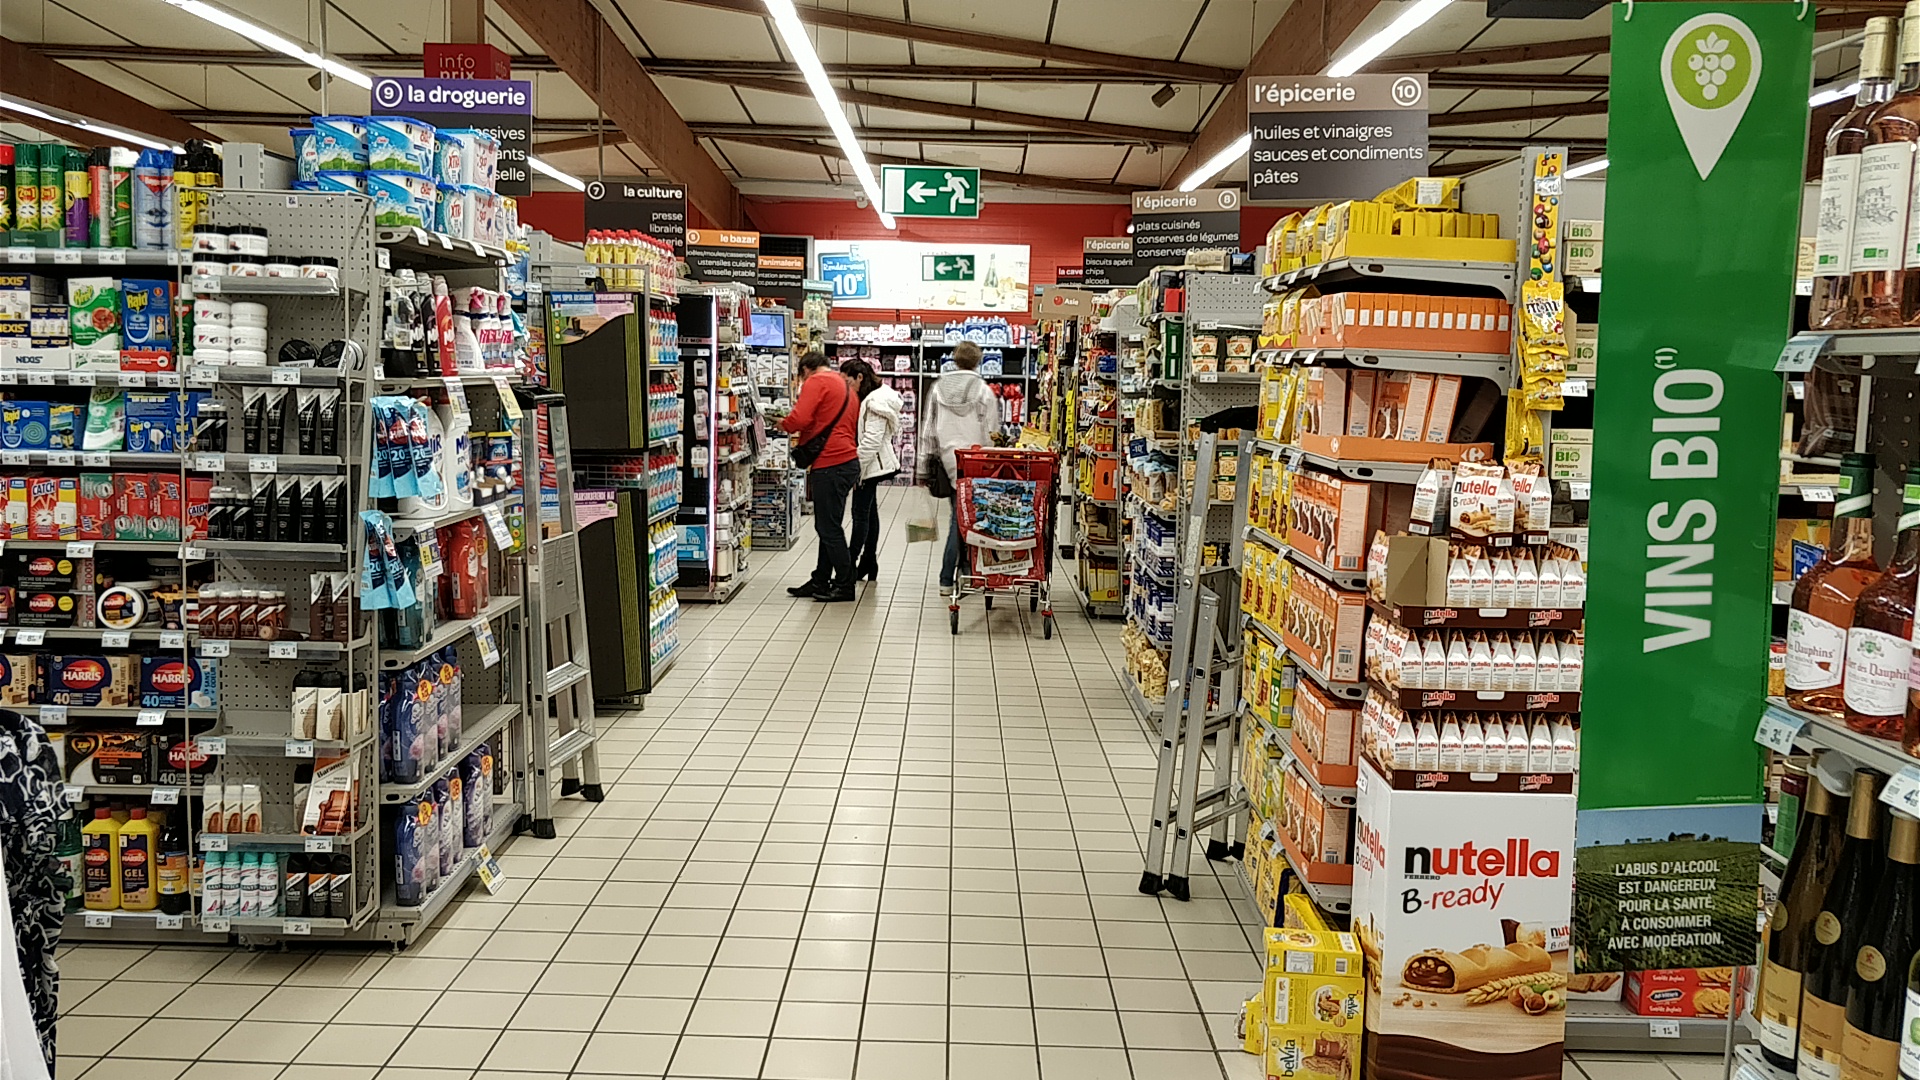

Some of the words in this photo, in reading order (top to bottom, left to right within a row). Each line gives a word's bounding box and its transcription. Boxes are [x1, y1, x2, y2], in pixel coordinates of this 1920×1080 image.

[439, 53, 476, 69] info
[383, 87, 395, 101] 9
[408, 85, 426, 103] la
[429, 85, 526, 109] droguerie
[1254, 82, 1356, 107] l'épicerie
[1397, 84, 1416, 99] 10
[1253, 125, 1301, 140] huiles
[1303, 126, 1321, 140] et
[1322, 123, 1393, 141] vinaigres
[497, 148, 526, 161] ants
[1253, 149, 1309, 162] sauces
[1311, 147, 1328, 161] et
[1330, 145, 1424, 160] condiments
[495, 167, 526, 182] selle
[1253, 168, 1299, 187] pâtes
[623, 185, 635, 198] la
[637, 186, 683, 199] culture
[1136, 194, 1197, 210] l'épicerie
[652, 212, 683, 221] presse
[649, 223, 683, 234] librairie
[1136, 220, 1160, 233] plats
[1161, 218, 1201, 230] cuisinés
[1571, 227, 1593, 237] BIO
[720, 234, 729, 243] le
[730, 234, 757, 244] bazar
[1136, 234, 1185, 245] conserves
[1185, 233, 1198, 243] de
[1199, 232, 1239, 244] légumes
[1086, 240, 1130, 251] l'épicerie
[1136, 247, 1187, 258] conserves
[1570, 247, 1594, 258] BIO
[697, 259, 731, 267] ustensiles
[732, 260, 756, 268] cuisine
[1085, 258, 1113, 266] biscuits
[703, 268, 731, 276] vaisselle
[732, 269, 756, 278] jetable
[1058, 268, 1066, 276] la
[1085, 268, 1105, 276] chips
[127, 292, 148, 308] Raid
[16, 356, 43, 364] NEXIS
[390, 449, 406, 460] 20
[414, 450, 426, 459] 20
[1555, 451, 1581, 462] BIO
[32, 480, 56, 497] CATCH
[1454, 480, 1498, 496] nutella
[188, 502, 209, 517] CATCH
[29, 564, 54, 572] HARRIS
[369, 562, 381, 573] 20
[389, 562, 400, 572] 20
[1643, 498, 1718, 654] VINS
[29, 600, 55, 608] HARRIS
[1424, 608, 1458, 618] nutella
[1529, 610, 1562, 620] nutella
[1795, 640, 1835, 659] Dauphins
[1769, 655, 1784, 665] etit
[62, 671, 102, 682] HARRIS
[152, 673, 192, 684] HARRIS
[53, 692, 70, 705] 40
[1271, 684, 1280, 706] 12
[1422, 691, 1456, 701] nutella
[1526, 693, 1560, 703] nutella
[142, 695, 160, 707] 40
[77, 741, 91, 749] ZIP
[168, 751, 208, 762] HARRIS
[159, 772, 176, 784] 40
[1415, 773, 1449, 782] nutella
[1520, 774, 1553, 784] nutella
[1358, 815, 1386, 869] nutella
[1404, 838, 1560, 878] nutella
[87, 868, 108, 877] GEL
[124, 868, 145, 878] GEL
[1615, 861, 1658, 876] L'ABUS
[1661, 859, 1721, 875] D'ALCOOL
[1618, 882, 1642, 894] EST
[1644, 877, 1717, 893] DANGEREUX
[1401, 879, 1505, 914] B-ready
[1618, 899, 1651, 913] POUR
[1653, 898, 1670, 911] LA
[1620, 916, 1631, 931] À
[1632, 914, 1712, 930] CONSOMMER
[1607, 935, 1640, 950] AVEC
[1642, 930, 1725, 949] MODÉRATION.
[1278, 1039, 1296, 1078] belVita
